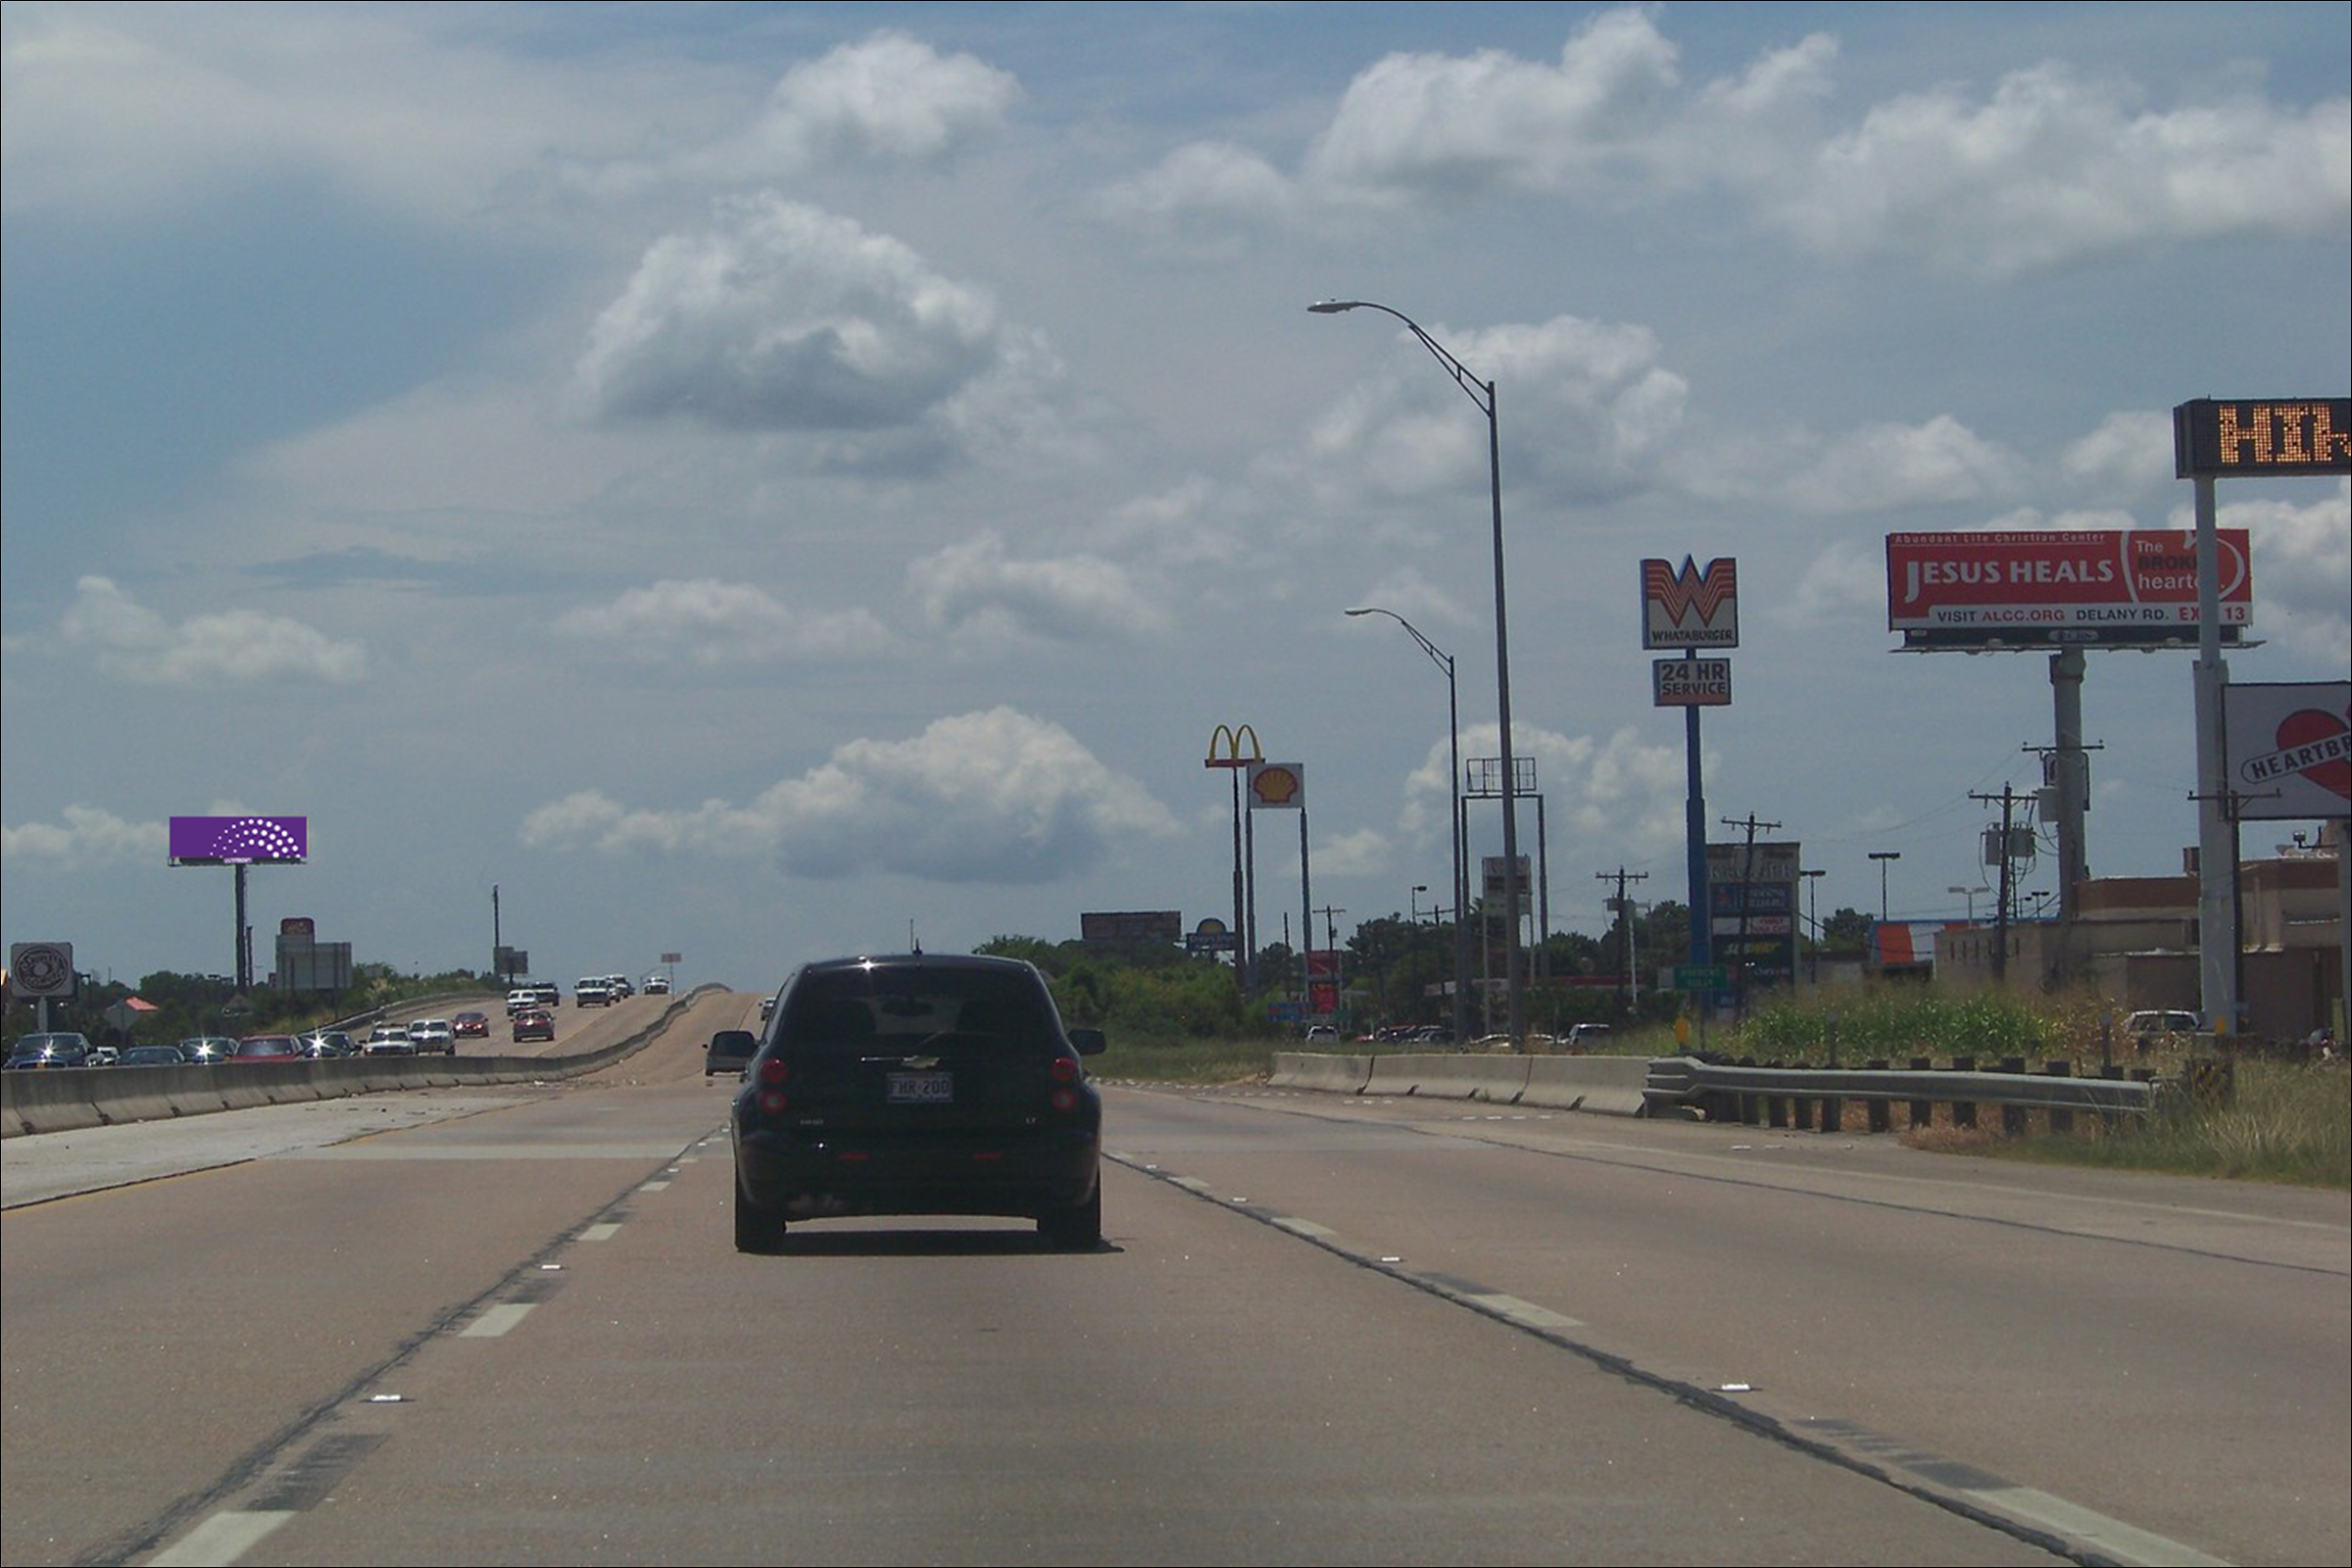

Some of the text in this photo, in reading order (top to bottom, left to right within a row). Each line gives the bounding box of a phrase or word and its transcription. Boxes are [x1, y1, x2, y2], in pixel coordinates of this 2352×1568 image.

[1895, 535, 1958, 544] Abundant
[1995, 533, 2056, 543] Christian
[2062, 532, 2105, 542] Center
[2135, 540, 2165, 553] The
[2138, 555, 2198, 571] BROK
[1904, 560, 2114, 604] JESUS HEALS
[1937, 610, 1977, 622] VISIT
[1982, 609, 2066, 622] ALCC.ORG
[2076, 608, 2137, 621] DELANY
[2142, 608, 2170, 620] RD.
[2225, 607, 2246, 620] 13
[1651, 629, 1734, 643] WHATABURGER
[1661, 662, 1726, 682] 24 HR
[1662, 681, 1727, 697] SERVICE
